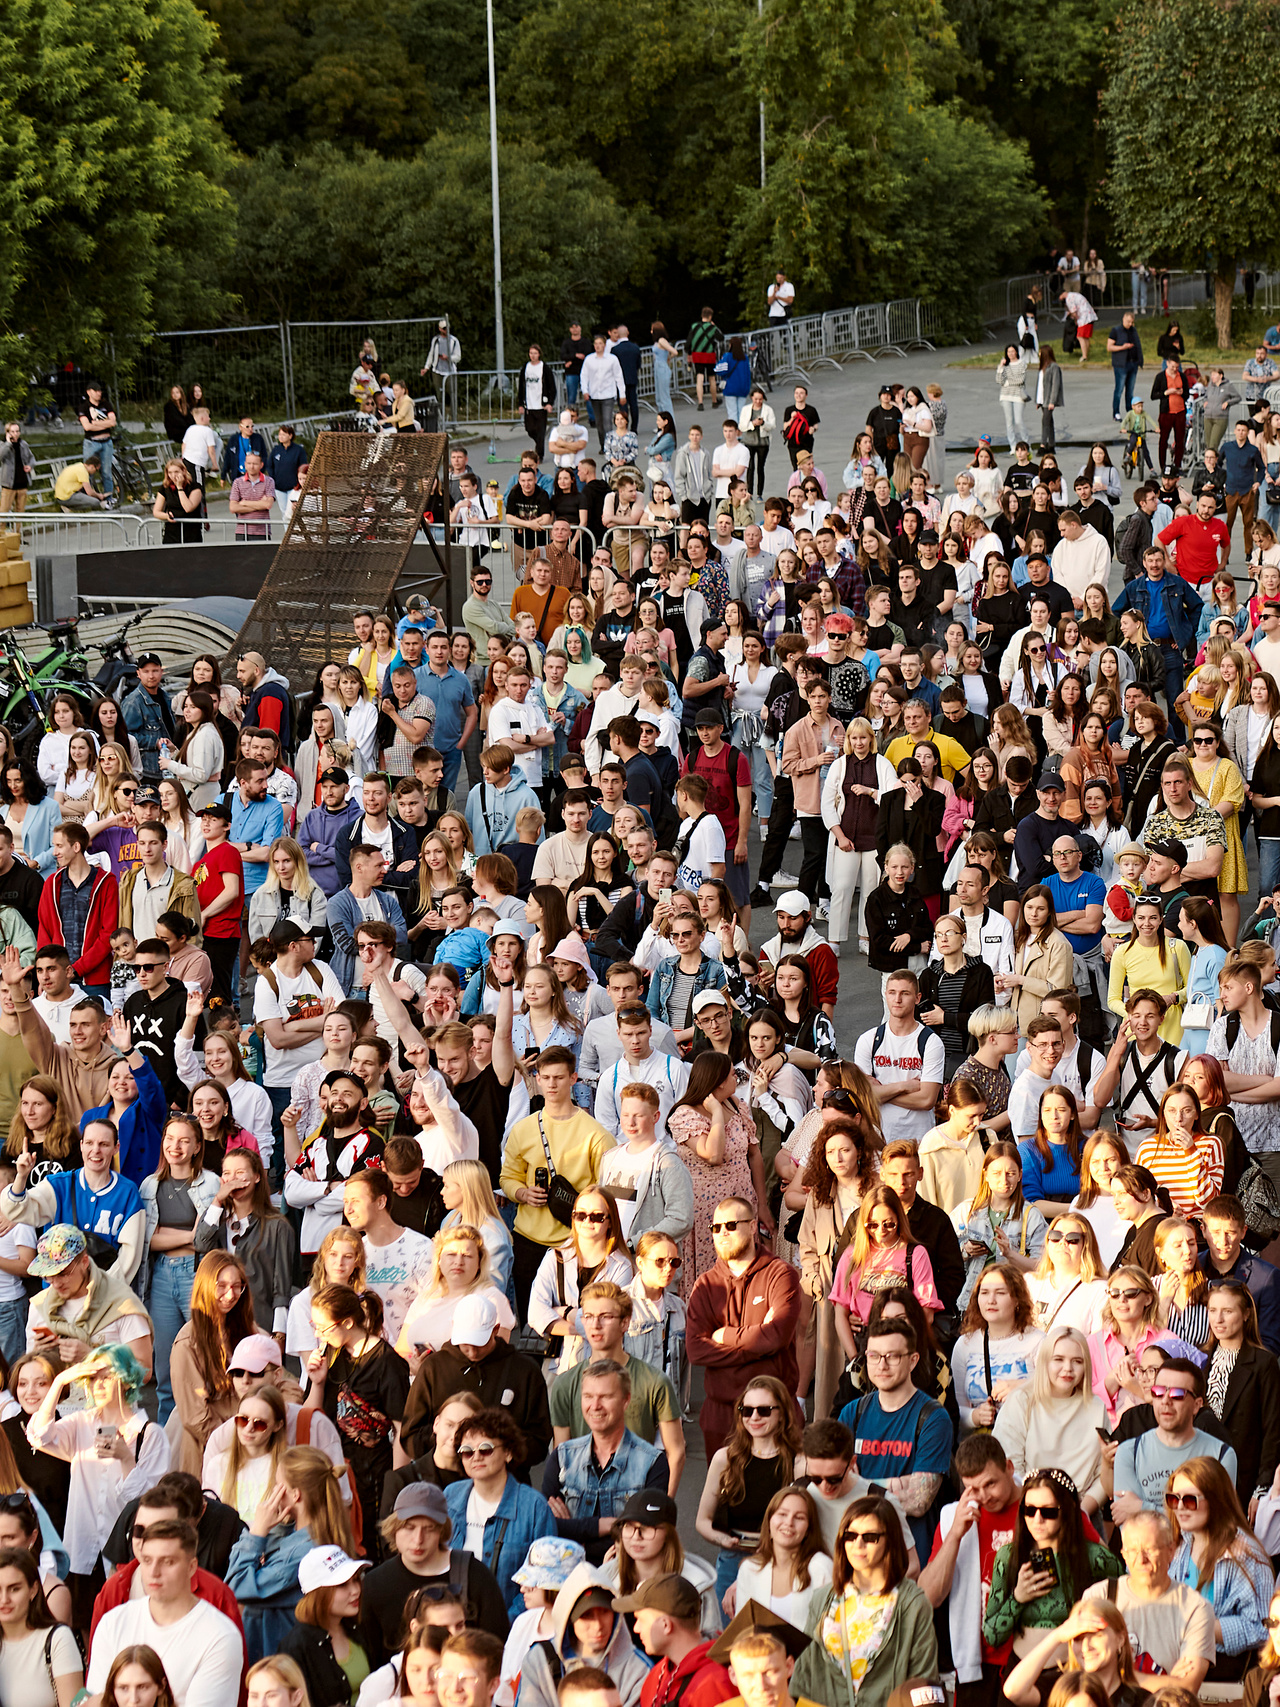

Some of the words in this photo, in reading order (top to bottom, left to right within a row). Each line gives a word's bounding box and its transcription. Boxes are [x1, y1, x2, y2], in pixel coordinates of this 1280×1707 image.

[874, 1055, 892, 1068] TOM
[862, 1439, 913, 1458] BOSTON
[1141, 1470, 1174, 1488] QUIKS
